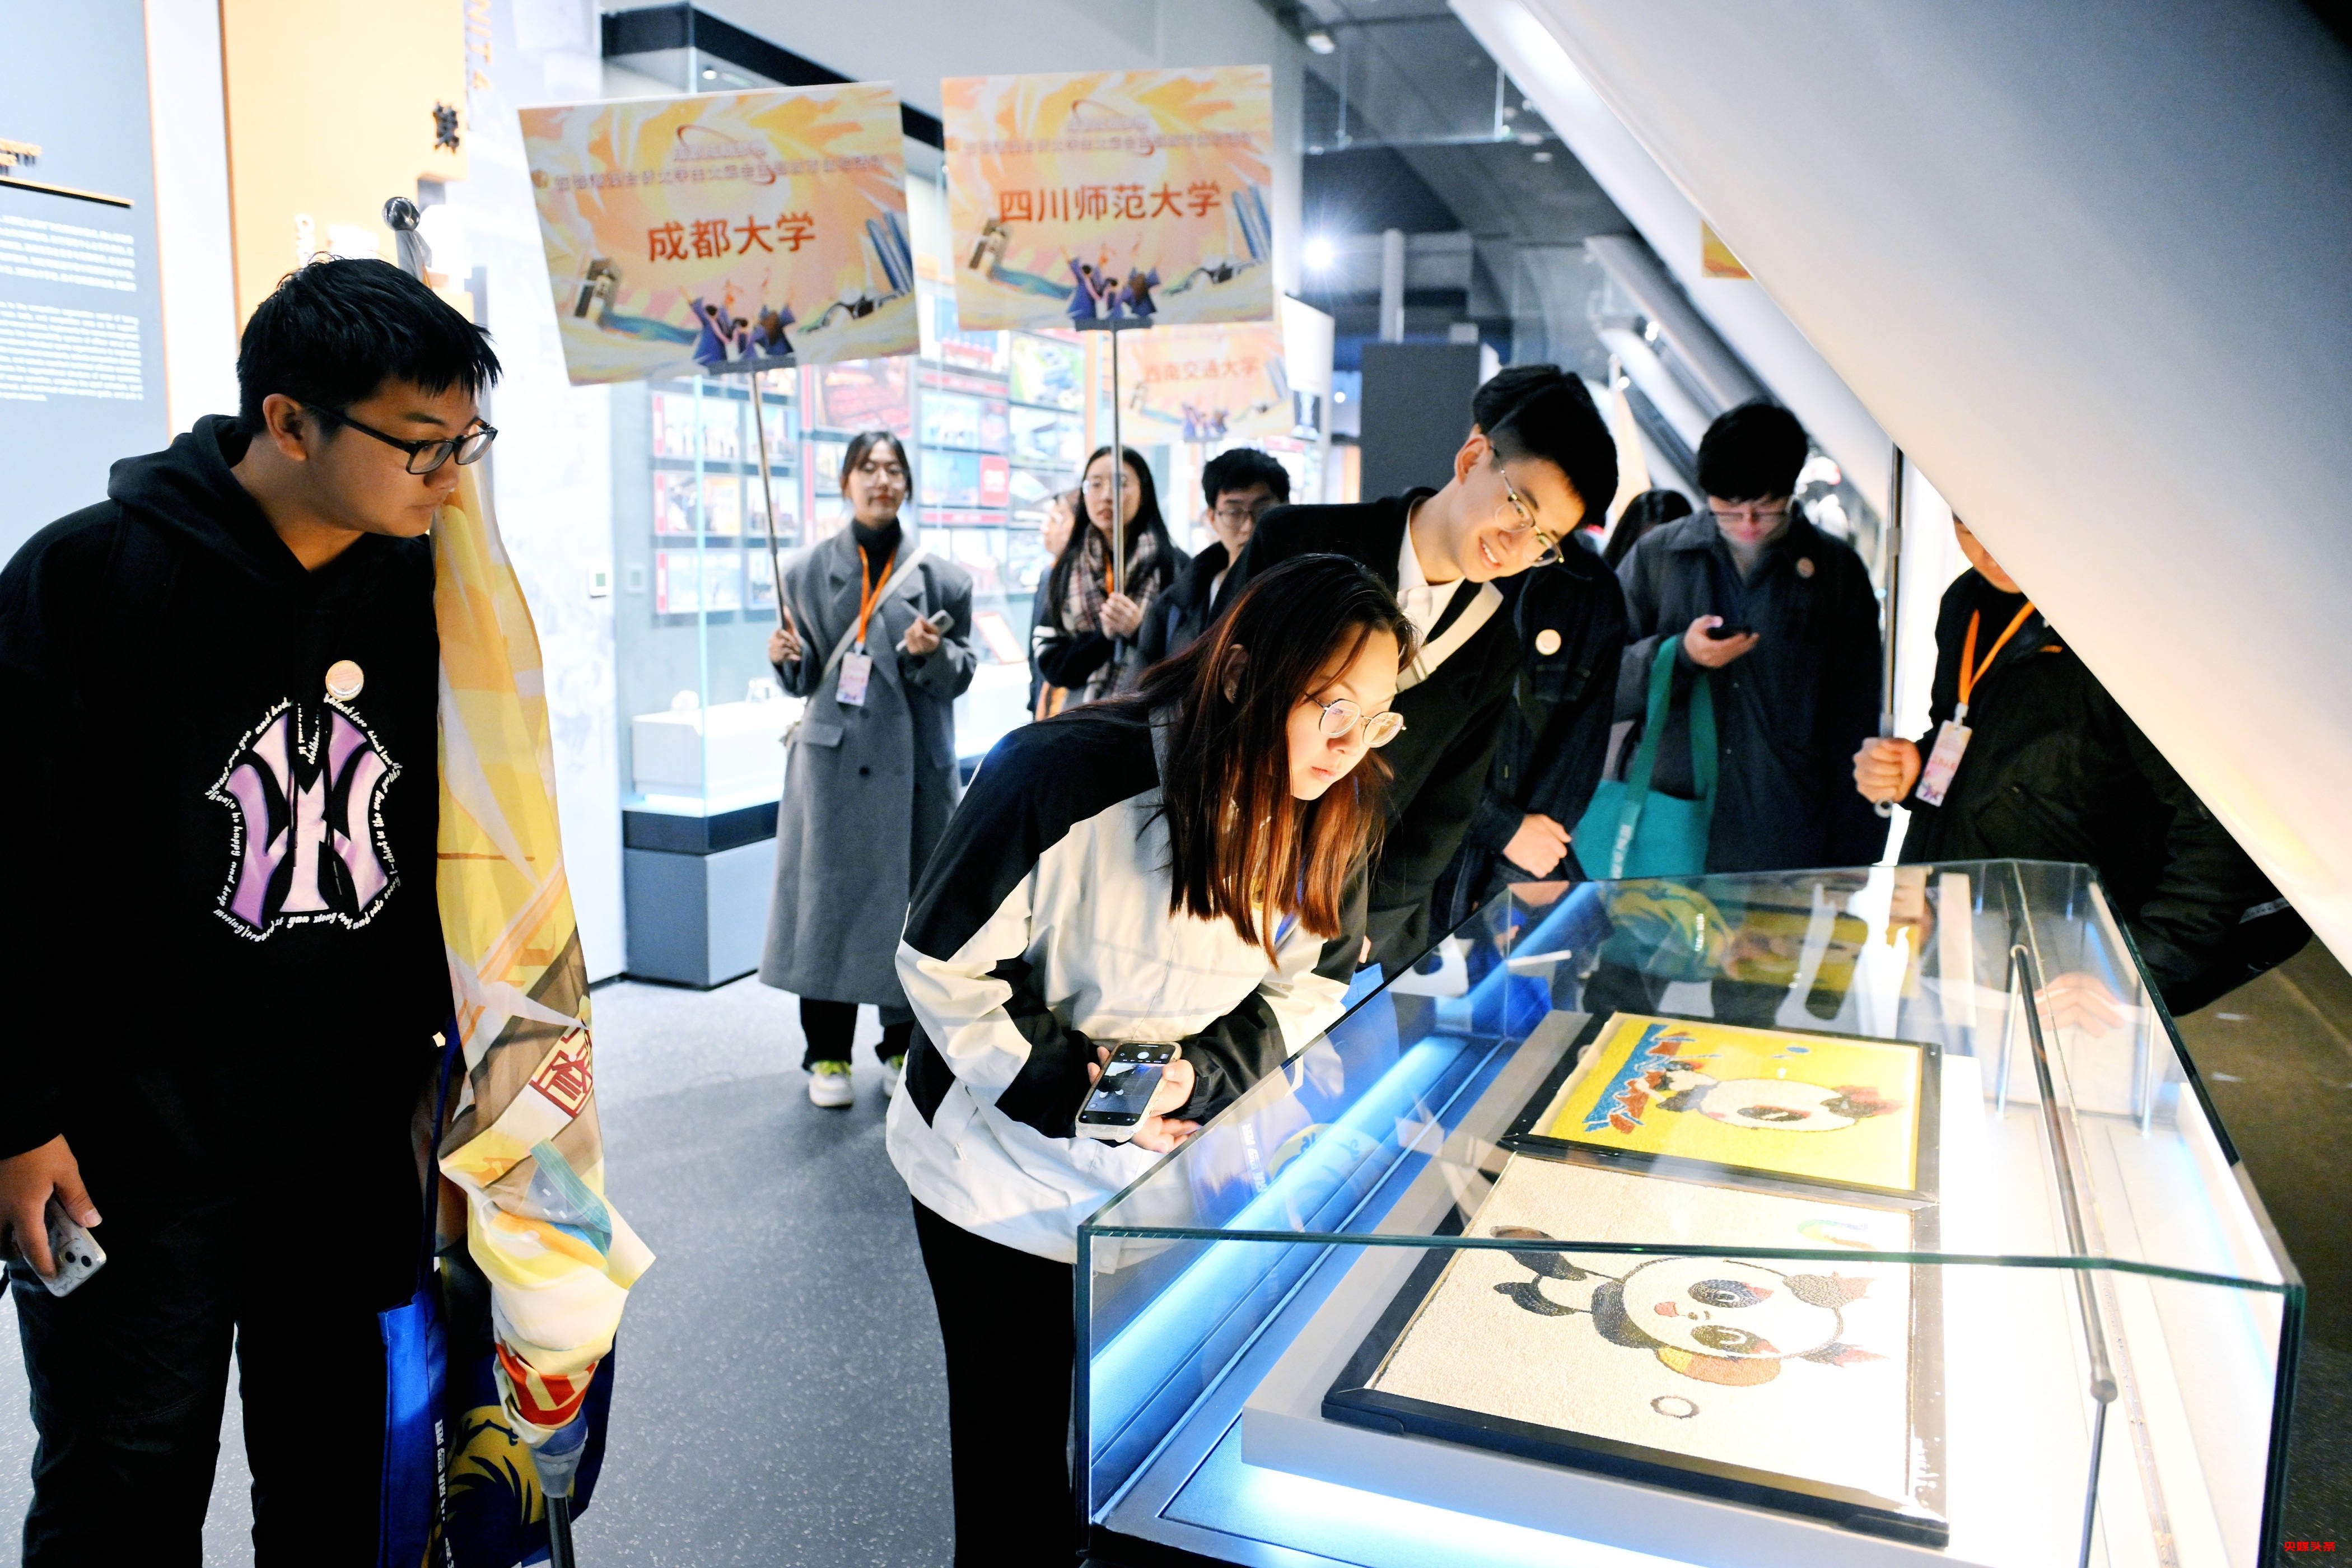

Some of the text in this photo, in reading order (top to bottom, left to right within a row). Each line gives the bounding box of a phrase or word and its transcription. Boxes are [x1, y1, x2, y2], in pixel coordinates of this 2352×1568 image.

[998, 180, 1222, 224] 四川师范大学
[647, 211, 816, 263] 成都大学
[255, 711, 272, 735] and
[230, 825, 243, 857] happy
[353, 911, 371, 930] and
